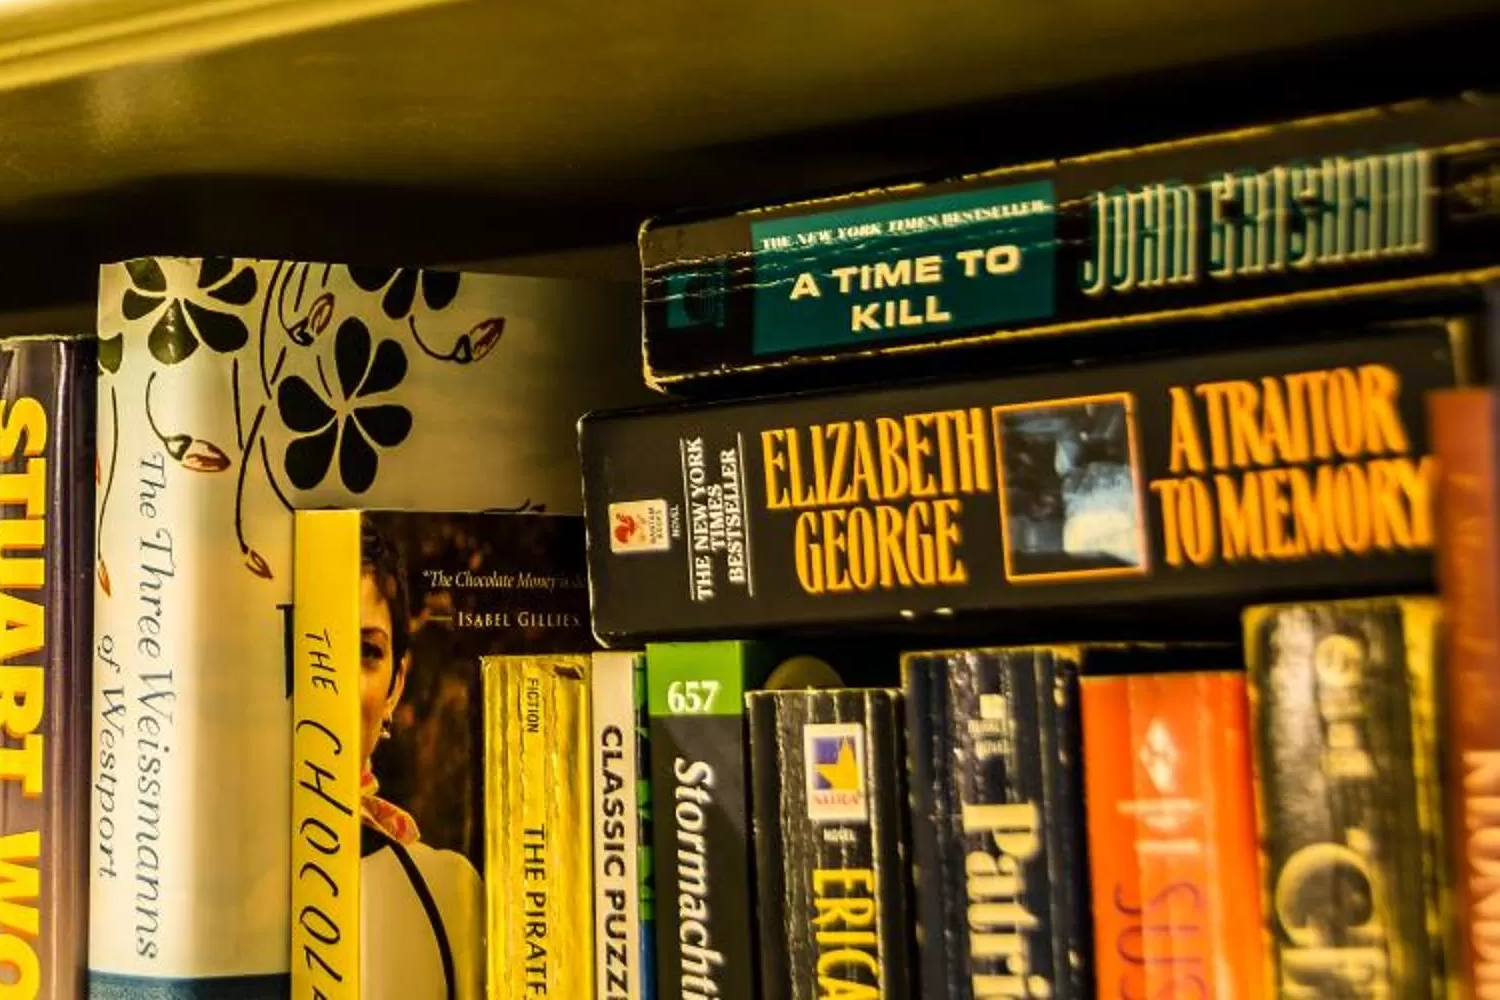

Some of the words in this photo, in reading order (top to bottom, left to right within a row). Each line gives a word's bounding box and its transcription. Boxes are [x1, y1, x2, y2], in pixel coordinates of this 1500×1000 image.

[761, 235, 792, 250] THE
[796, 229, 834, 246] NEW
[837, 223, 882, 241] YORK
[888, 216, 939, 234] TIMES
[789, 272, 821, 300] A
[830, 256, 943, 294] TIME
[956, 245, 1022, 277] TO
[851, 296, 953, 332] KILL
[1169, 386, 1202, 474] A
[1196, 364, 1410, 471] TRAITOR
[138, 453, 167, 520] The
[686, 436, 706, 499] YORK
[761, 406, 992, 509] ELIZABETH
[691, 503, 710, 551] NEW
[708, 483, 726, 552] TIMES
[720, 448, 746, 583] BESTSELLER
[1150, 470, 1216, 568] TO
[1212, 454, 1438, 564] MEMORY
[455, 570, 514, 588] Chocolate
[516, 572, 557, 592] Money
[696, 555, 715, 601] THE
[794, 499, 968, 596] GEORGE
[137, 529, 175, 659] Three
[458, 611, 512, 627] ISABEL
[517, 611, 582, 627] GILLIES
[97, 635, 120, 673] of
[304, 628, 340, 696] THE
[527, 677, 541, 734] FICTION
[667, 681, 721, 713] 657
[96, 685, 126, 878] Westport
[135, 671, 176, 960] Weissmanns
[600, 726, 625, 879] CLASSIC
[522, 823, 547, 882] THE
[961, 798, 1052, 1000] Patri
[524, 889, 549, 1000] PIRATE
[812, 867, 881, 1000] ERICA
